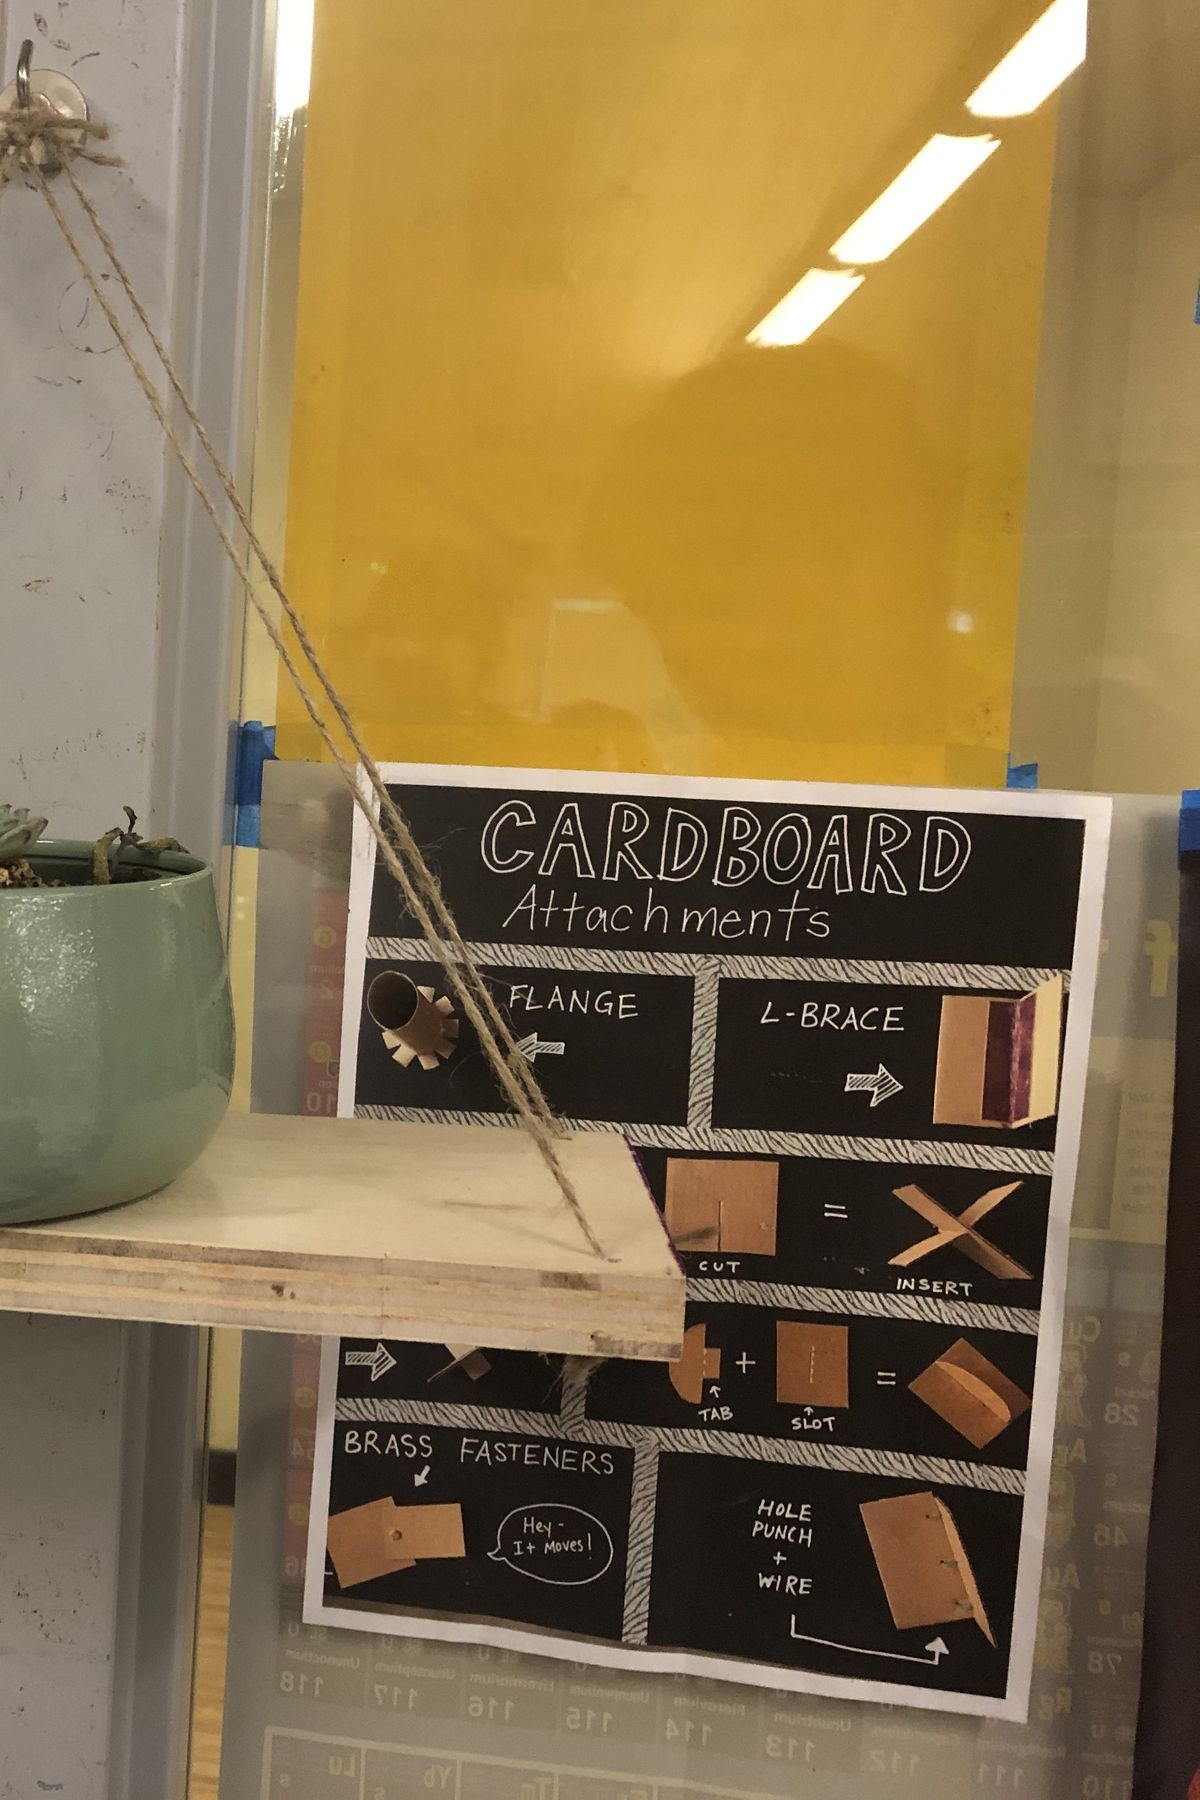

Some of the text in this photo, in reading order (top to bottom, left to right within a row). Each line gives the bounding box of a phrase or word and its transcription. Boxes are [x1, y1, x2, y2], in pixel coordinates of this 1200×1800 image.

[480, 799, 972, 896] CARDBOARD
[501, 884, 831, 941] Attachments
[509, 984, 639, 1020] FLANGE
[760, 1000, 905, 1033] L-BRACE
[698, 1260, 741, 1274] CUT
[896, 1277, 973, 1298] INSERT
[697, 1405, 734, 1423] TAB
[791, 1416, 836, 1434] SLOT
[343, 1430, 615, 1475] BRASS FASTENERS
[756, 1498, 812, 1523] HOLE
[751, 1519, 813, 1549] PUNCH
[757, 1571, 813, 1597] WIRE
